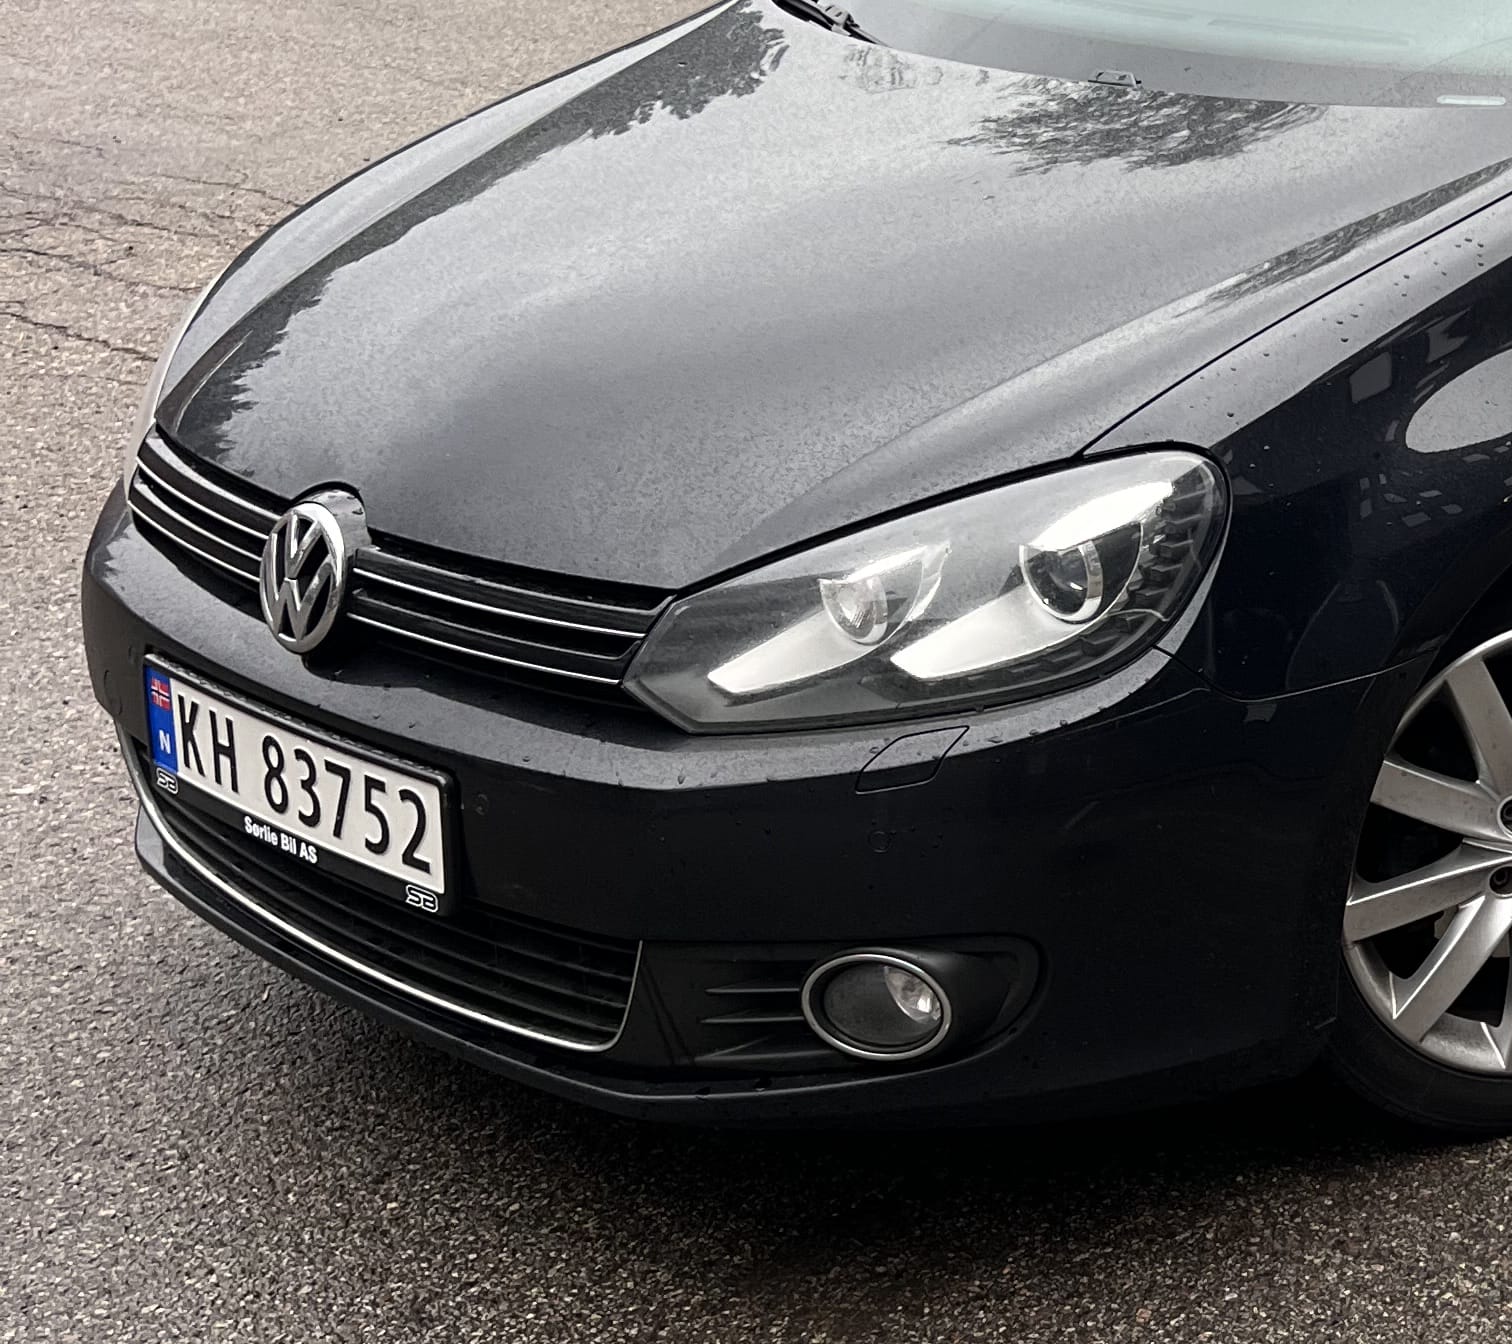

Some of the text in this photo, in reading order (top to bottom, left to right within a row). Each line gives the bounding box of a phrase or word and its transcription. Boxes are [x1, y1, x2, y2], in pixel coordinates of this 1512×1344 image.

[159, 730, 170, 754] N
[178, 694, 431, 874] KH 83752
[244, 816, 318, 864] Sørlie Bil AS
